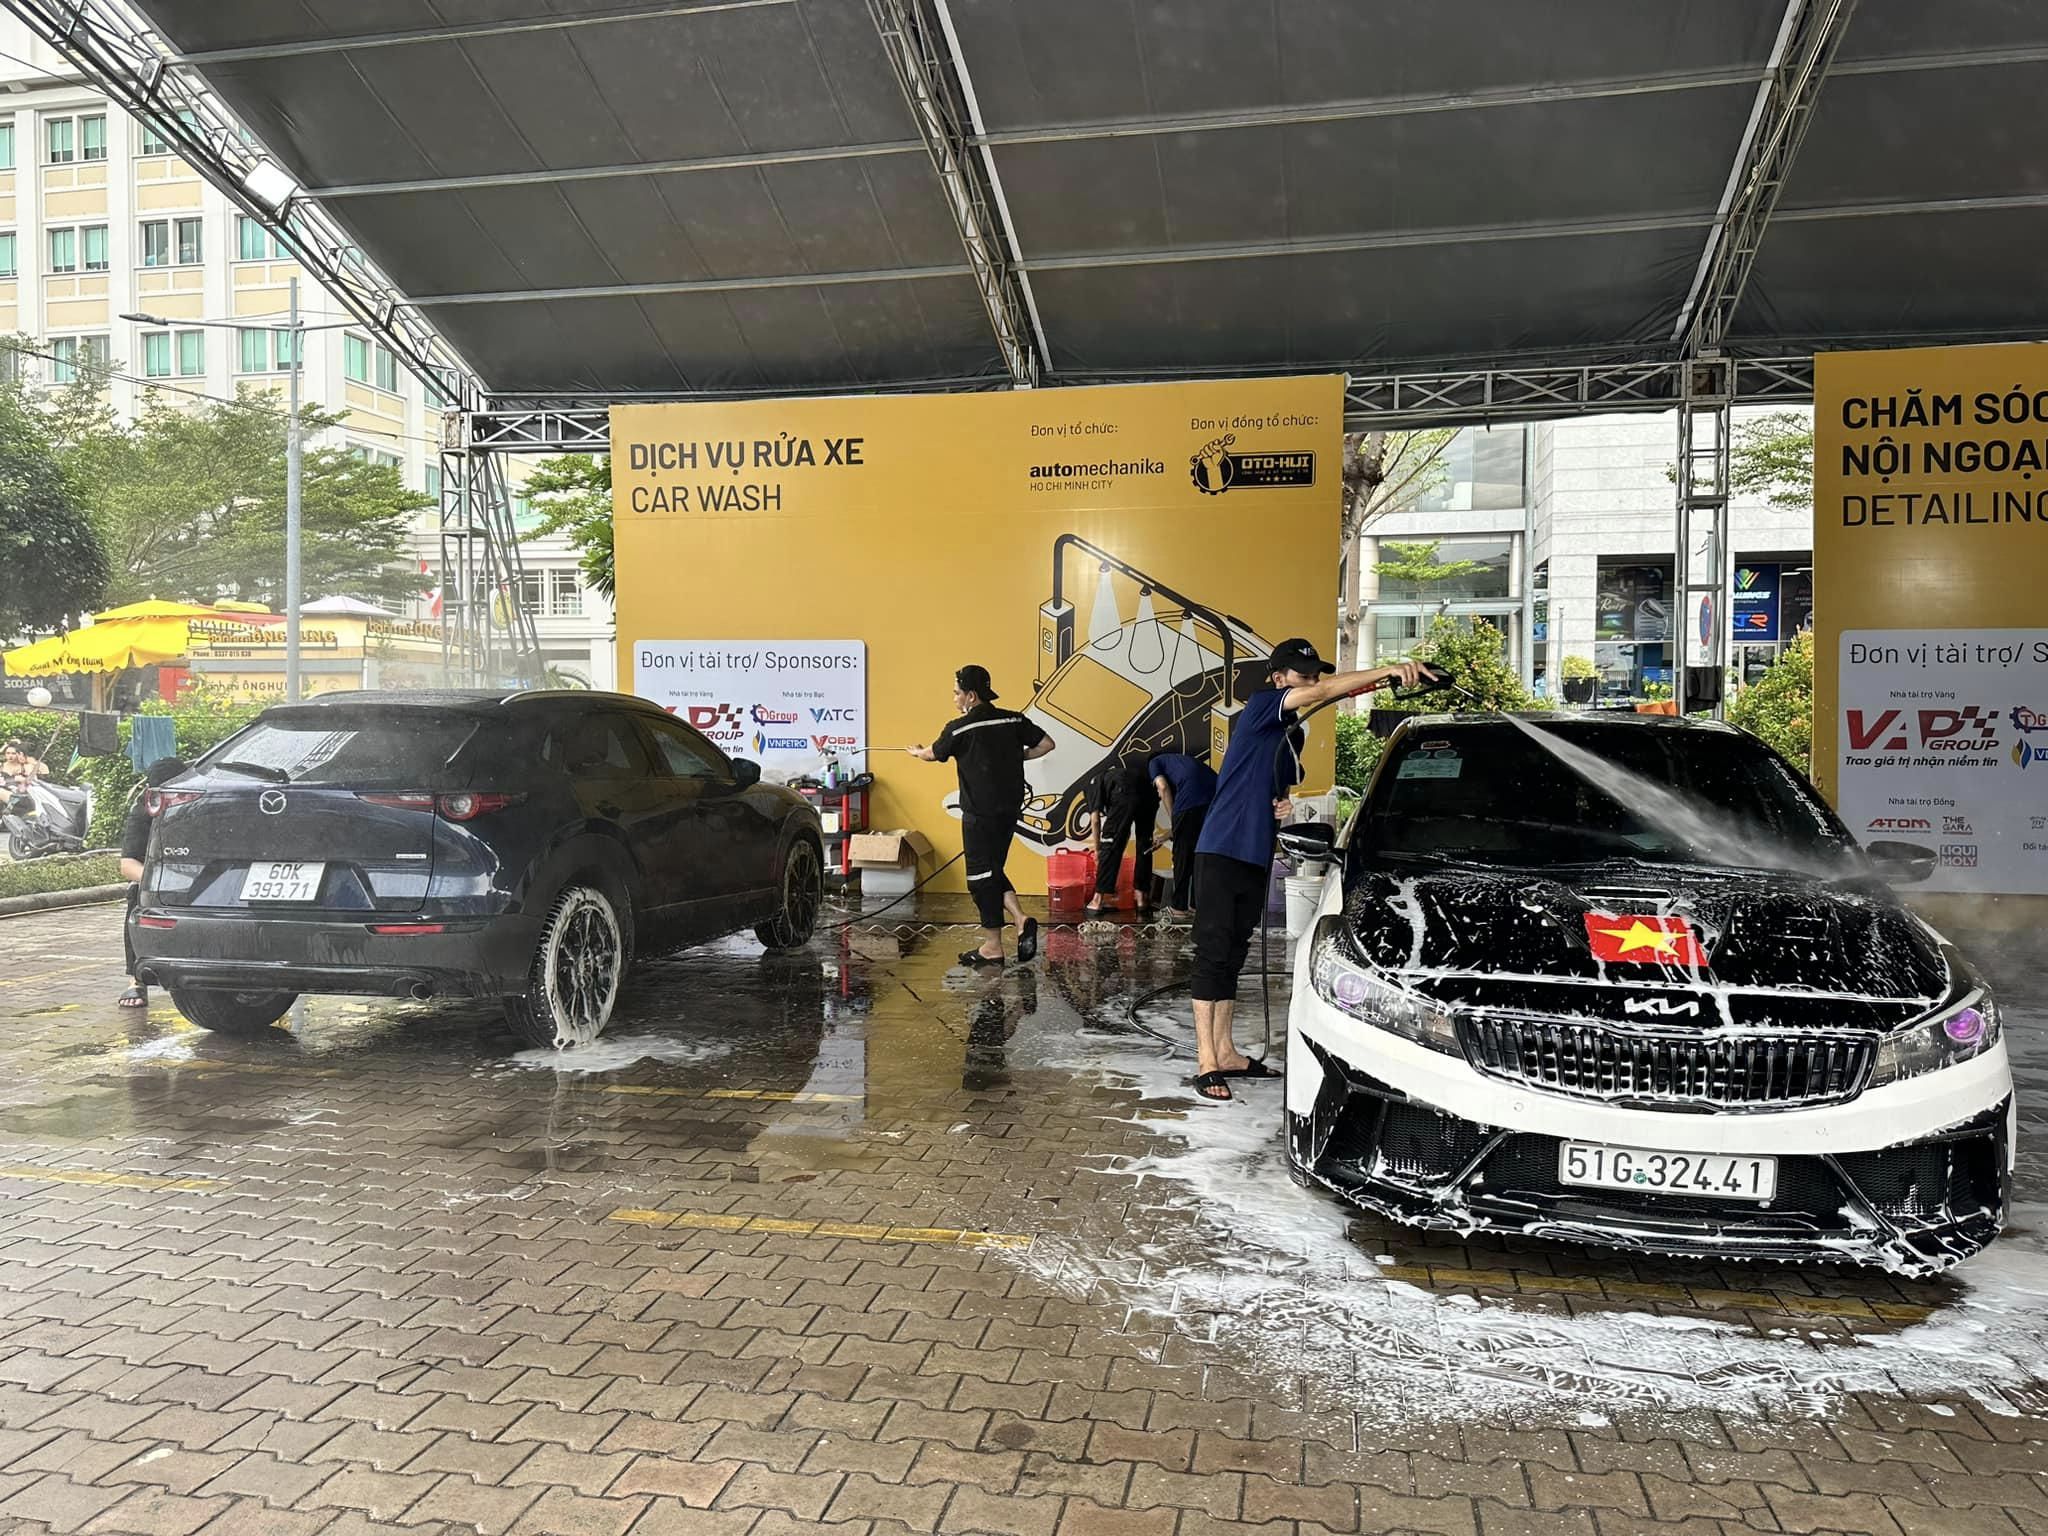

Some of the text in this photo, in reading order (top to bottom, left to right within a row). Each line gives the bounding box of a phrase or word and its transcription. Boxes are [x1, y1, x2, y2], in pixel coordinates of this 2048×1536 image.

[1842, 388, 1962, 429] CHĂM
[1031, 421, 1118, 438] Đơn vị tổ chức:
[1191, 418, 1215, 430] Đơn
[1219, 417, 1228, 431] vị
[1267, 412, 1279, 427] tổ
[1282, 413, 1318, 426] chức:
[630, 431, 864, 477] DỊCH VỤ RỬA XE
[1842, 436, 1910, 483] NỘI
[1030, 459, 1165, 478] automechanika
[1241, 456, 1309, 469] OTO-HUI
[1046, 482, 1062, 491] CHI
[1064, 481, 1089, 490] MINH
[1091, 480, 1113, 489] CITY
[632, 484, 781, 513] CAR WASH
[641, 651, 857, 673] Đơn vị tài trợ/ Sponsors:
[1850, 643, 1898, 664] Đơn
[1907, 643, 1927, 668] vị
[1935, 643, 1967, 664] tài
[1976, 642, 2024, 668] trợ/
[4, 679, 44, 688] SOOSAN
[1921, 691, 1933, 699] trợ
[1935, 690, 1955, 699] Vàng
[809, 707, 854, 723] VATC
[768, 739, 807, 749] VNPETRO
[1929, 740, 1999, 751] GROUP
[1845, 756, 1872, 766] Trao
[1874, 755, 1896, 768] giá
[1898, 756, 1910, 768] trị
[1913, 756, 1944, 768] nhận
[1982, 757, 1998, 766] tin
[1934, 797, 1955, 807] Đồng
[1868, 818, 1931, 828] ATOM
[1941, 846, 1976, 856] LIQUI
[1941, 856, 1976, 866] MOLY
[269, 863, 304, 880] 60K
[249, 882, 309, 899] 393.71
